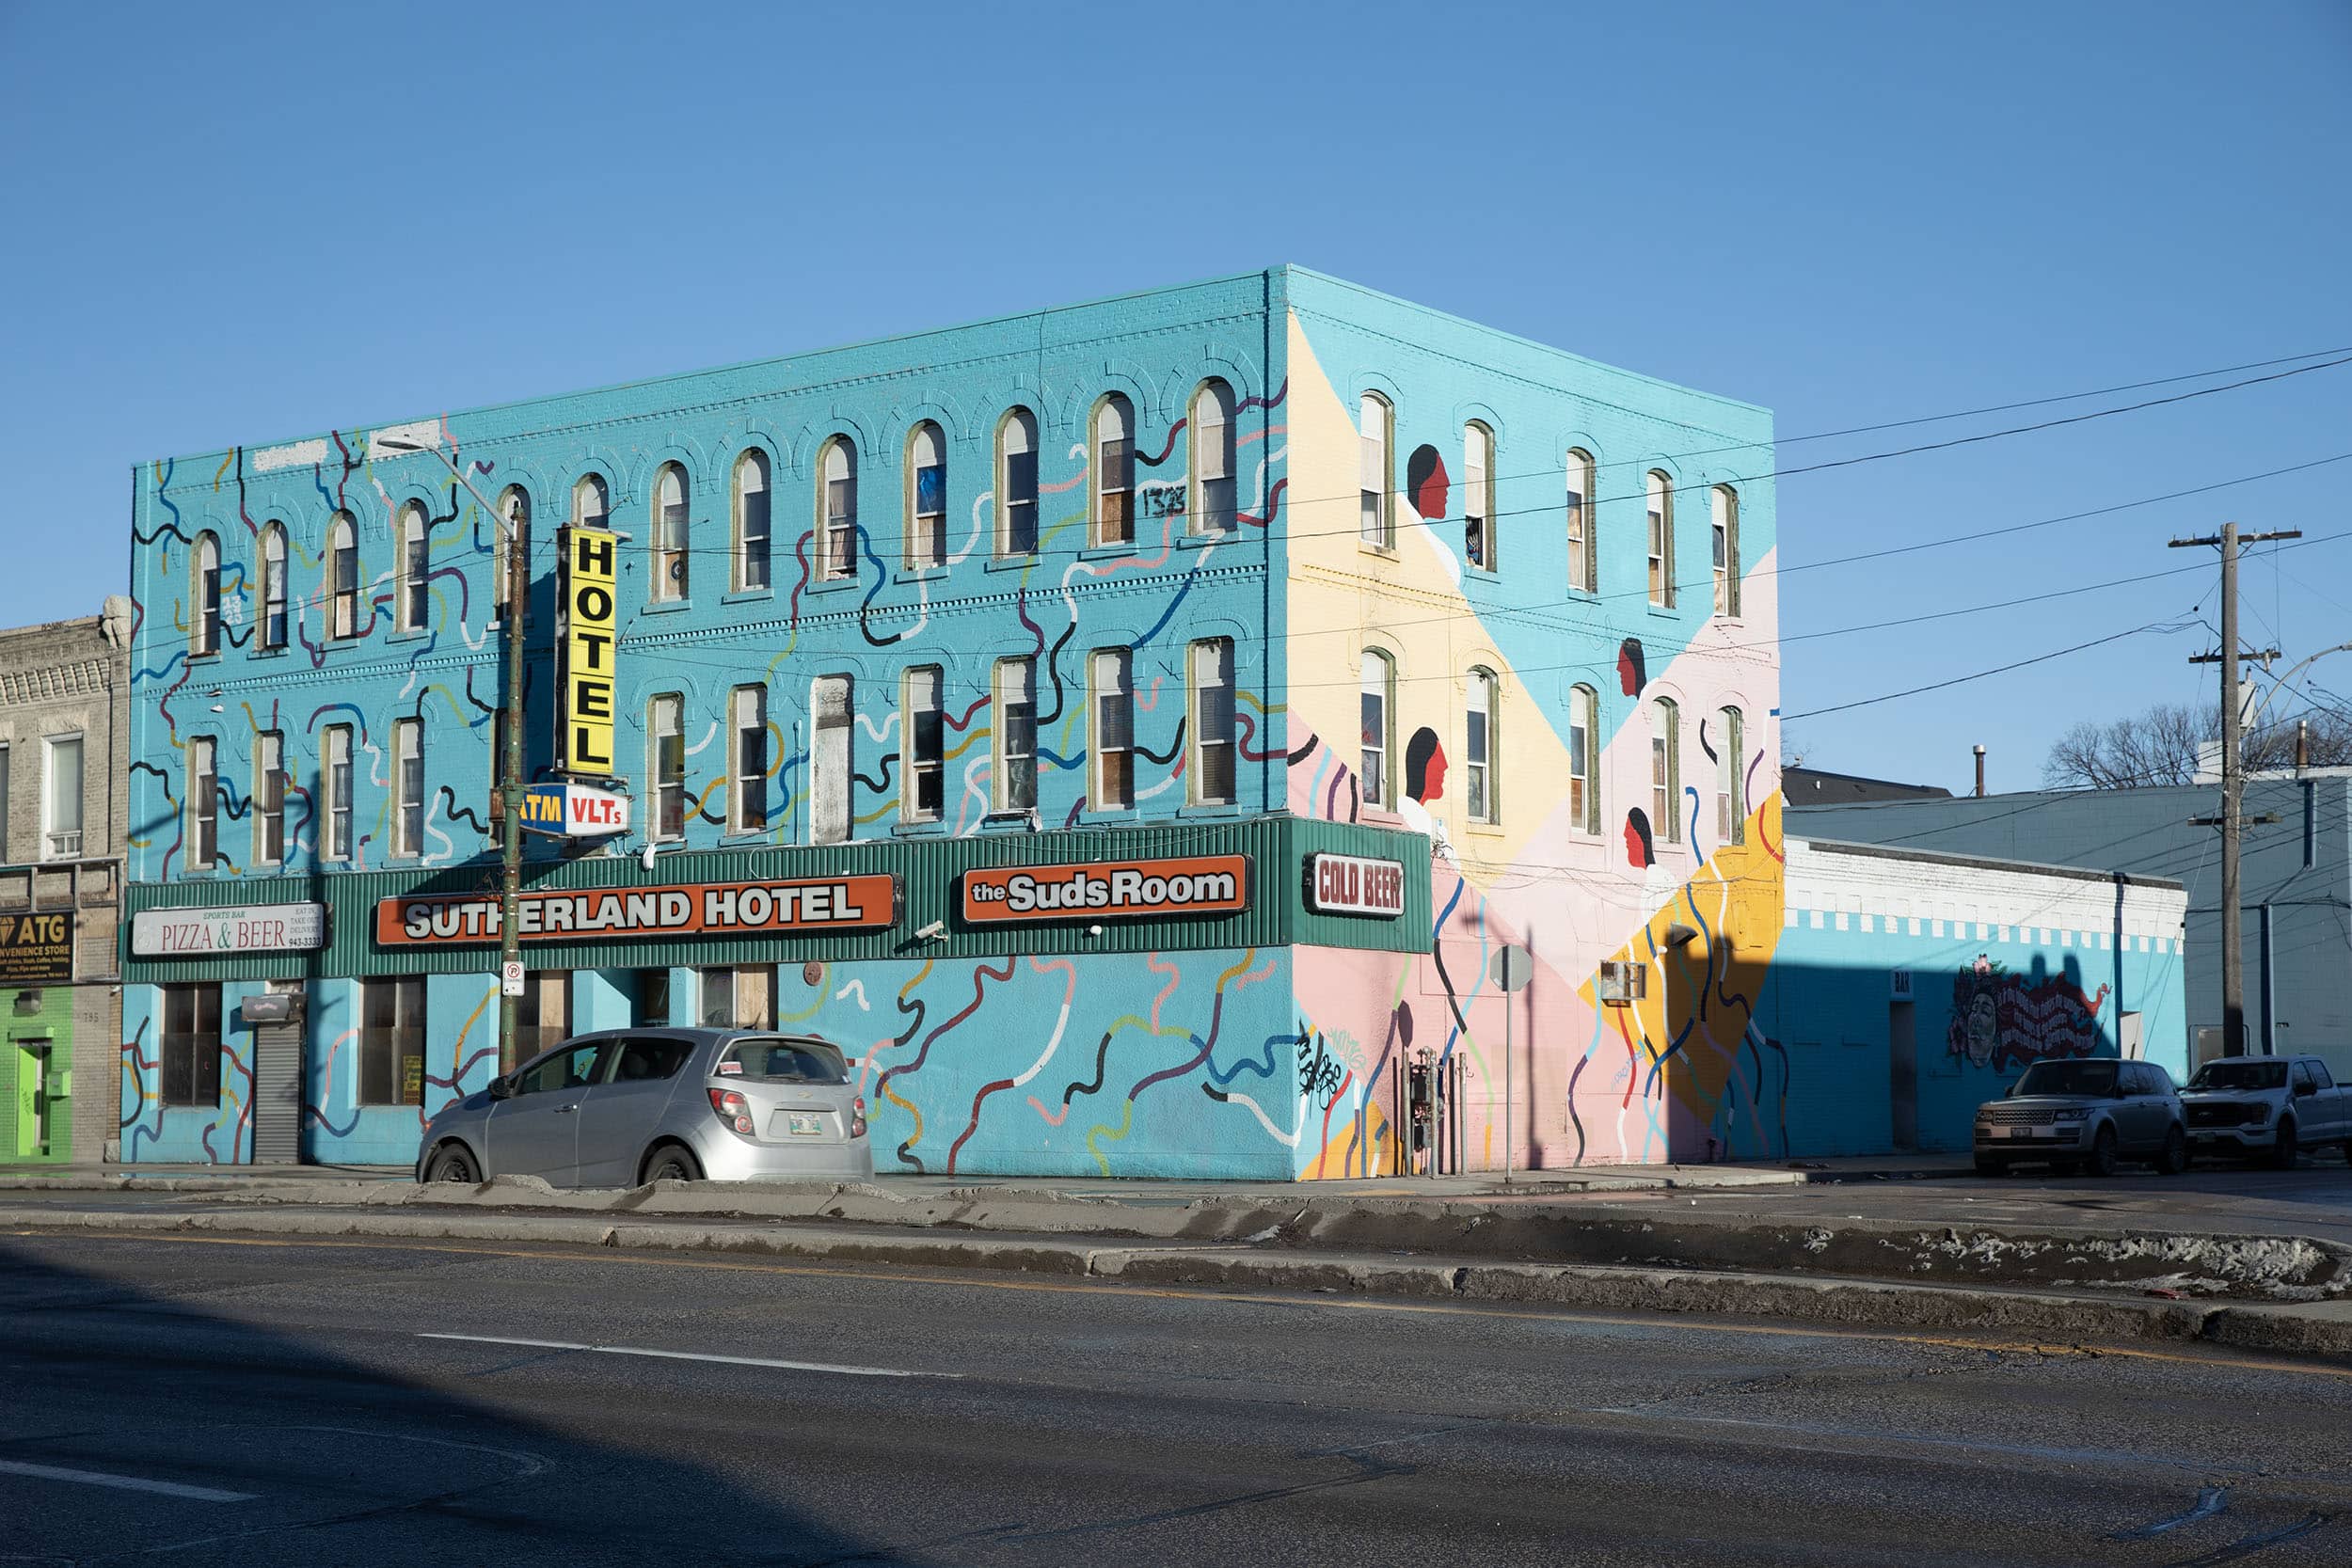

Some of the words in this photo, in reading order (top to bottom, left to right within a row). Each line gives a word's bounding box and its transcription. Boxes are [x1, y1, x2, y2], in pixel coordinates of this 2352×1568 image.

[577, 537, 612, 765] HOTEL
[572, 798, 621, 824] VLTs
[972, 882, 1006, 902] the
[1007, 871, 1109, 912] Suds
[1109, 868, 1236, 906] Room
[1319, 860, 1359, 905] COLD
[1363, 864, 1401, 909] BEER
[203, 911, 230, 921] SPORTS
[231, 911, 246, 919] BAR
[703, 883, 863, 927] HOTEL
[17, 914, 65, 943] ATG
[162, 924, 213, 951] PIZZA
[217, 922, 231, 949] &
[238, 920, 285, 948] BEER
[44, 944, 70, 956] STORE
[1895, 972, 1910, 993] BAR
